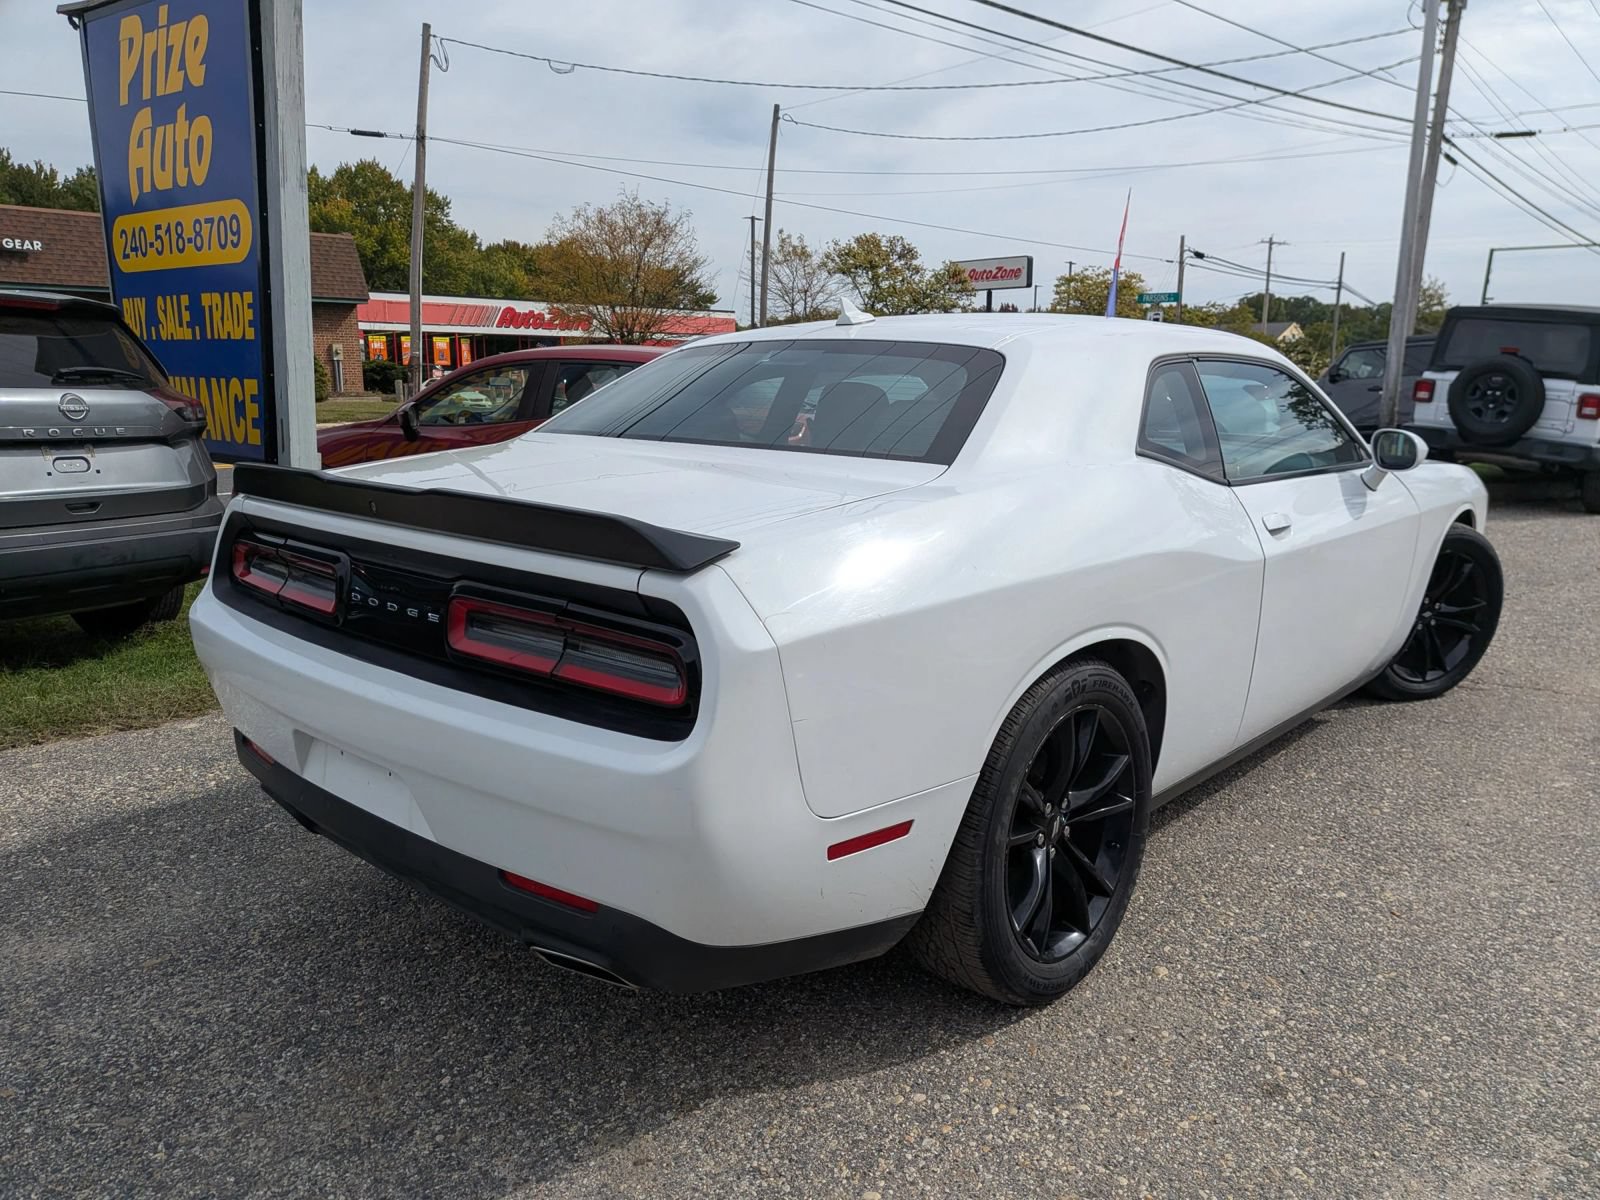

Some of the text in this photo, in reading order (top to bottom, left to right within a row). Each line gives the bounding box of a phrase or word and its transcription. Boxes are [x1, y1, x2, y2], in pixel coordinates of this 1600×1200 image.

[119, 4, 209, 106] Prize
[128, 102, 213, 207] Auto
[2, 237, 42, 251] GEAR
[119, 213, 241, 260] 240-518-8709
[967, 265, 1023, 282] AutoZone
[156, 293, 193, 341] SALE
[201, 291, 255, 340] TRADE
[22, 427, 127, 437] ROGUE
[351, 592, 440, 623] DODGE
